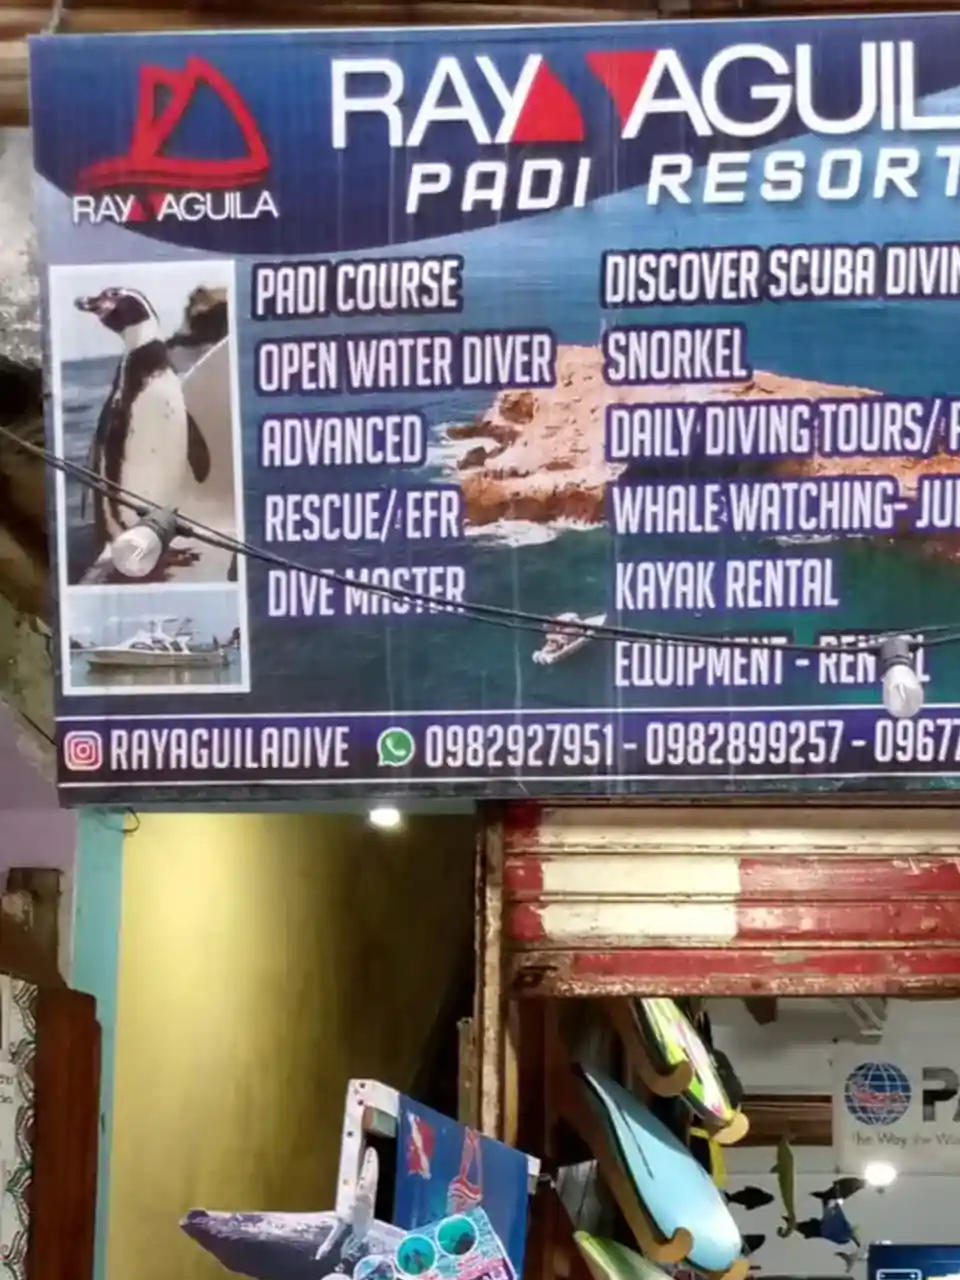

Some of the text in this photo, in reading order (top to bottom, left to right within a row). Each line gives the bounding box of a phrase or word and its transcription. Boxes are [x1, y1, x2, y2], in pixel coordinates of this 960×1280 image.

[331, 54, 542, 148] RAY
[72, 190, 278, 224] RAY AGUILA
[405, 156, 591, 214] PADI
[256, 259, 460, 315] PADI COURSE
[605, 250, 760, 303] DISCOVER
[769, 248, 878, 298] SCUBA
[257, 333, 553, 393] OPEN WATER DIVER
[606, 328, 748, 380] SNORKEL
[261, 413, 425, 466] ADVANCED
[611, 408, 695, 459] DAILY
[704, 405, 811, 456] DIVING
[405, 490, 460, 540] EFR
[612, 484, 721, 535] WHALE
[267, 565, 467, 619] DIVE MASTER
[614, 558, 840, 611] KAYAK RENTAL
[615, 637, 788, 687] EQUIPMENT
[819, 634, 931, 684] RENL
[111, 727, 350, 772] RAYAGUILADIVE
[425, 724, 613, 768] 0982927951
[646, 720, 844, 765] 0982899257
